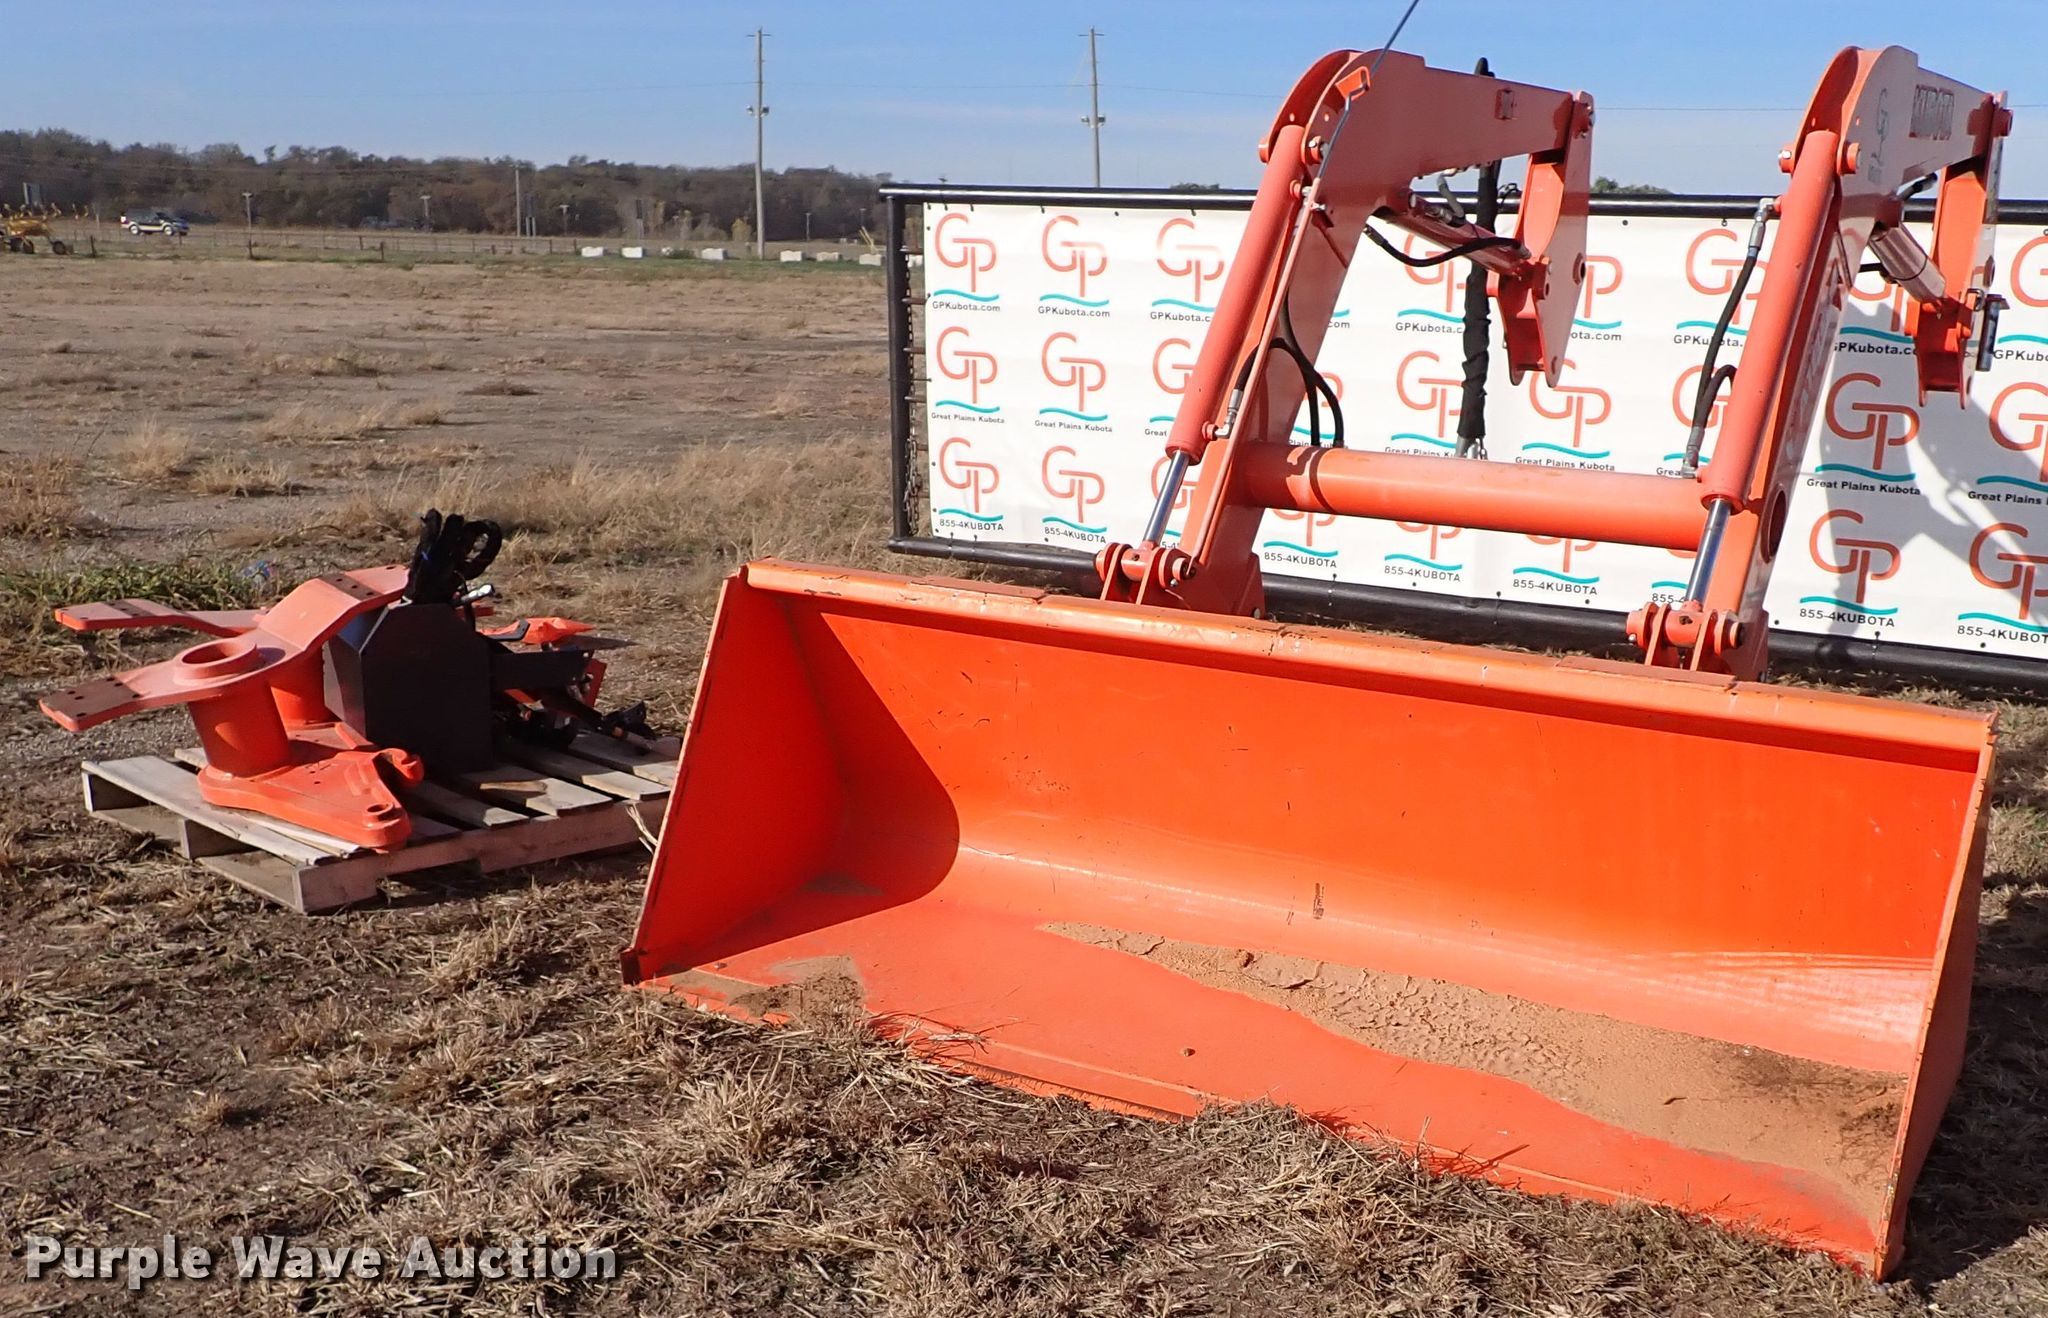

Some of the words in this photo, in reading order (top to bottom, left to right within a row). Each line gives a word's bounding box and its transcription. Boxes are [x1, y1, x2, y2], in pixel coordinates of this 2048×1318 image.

[935, 212, 997, 292] GP
[1042, 215, 1107, 298] GP
[932, 301, 1000, 312] GPKubota.com
[1038, 306, 1111, 317] GPKubota.com
[1150, 311, 1210, 322] GPKubota.c
[1395, 322, 1463, 334] GPKubota.c
[1571, 331, 1622, 341] ota.com
[1835, 341, 1915, 355] PKubota.c
[936, 326, 998, 403] GP
[1041, 332, 1106, 412] GP
[931, 412, 951, 420] Great
[953, 414, 976, 422] Plains
[978, 416, 1005, 424] Kubota
[1034, 420, 1056, 428] Great
[1058, 422, 1082, 430] Plains
[1085, 424, 1112, 432] Kubota
[1825, 372, 1920, 470] GP
[1515, 456, 1542, 465] Great
[1546, 458, 1575, 468] Plains
[1579, 462, 1615, 471] Kubota
[1656, 466, 1682, 476] Grea
[939, 437, 999, 513] GP
[1041, 445, 1105, 523] GP
[1806, 478, 1838, 489] Great
[1841, 481, 1875, 491] Plains
[1880, 484, 1920, 495] Kubota
[1968, 491, 2001, 502] Great
[2005, 493, 2042, 505] Plains
[939, 519, 1004, 531] 855-4KUBOTA
[1044, 527, 1106, 544] 855-4KUBOTA
[1264, 552, 1337, 569] 855-4KUBOTA
[1809, 509, 1901, 604] GP
[1384, 565, 1460, 582] 855-4KUBOTA
[1513, 579, 1598, 596] 855-4KUBOTA
[1799, 608, 1895, 628] 855-4KUBOTA
[1957, 624, 2048, 644] 855-4KUBOT
